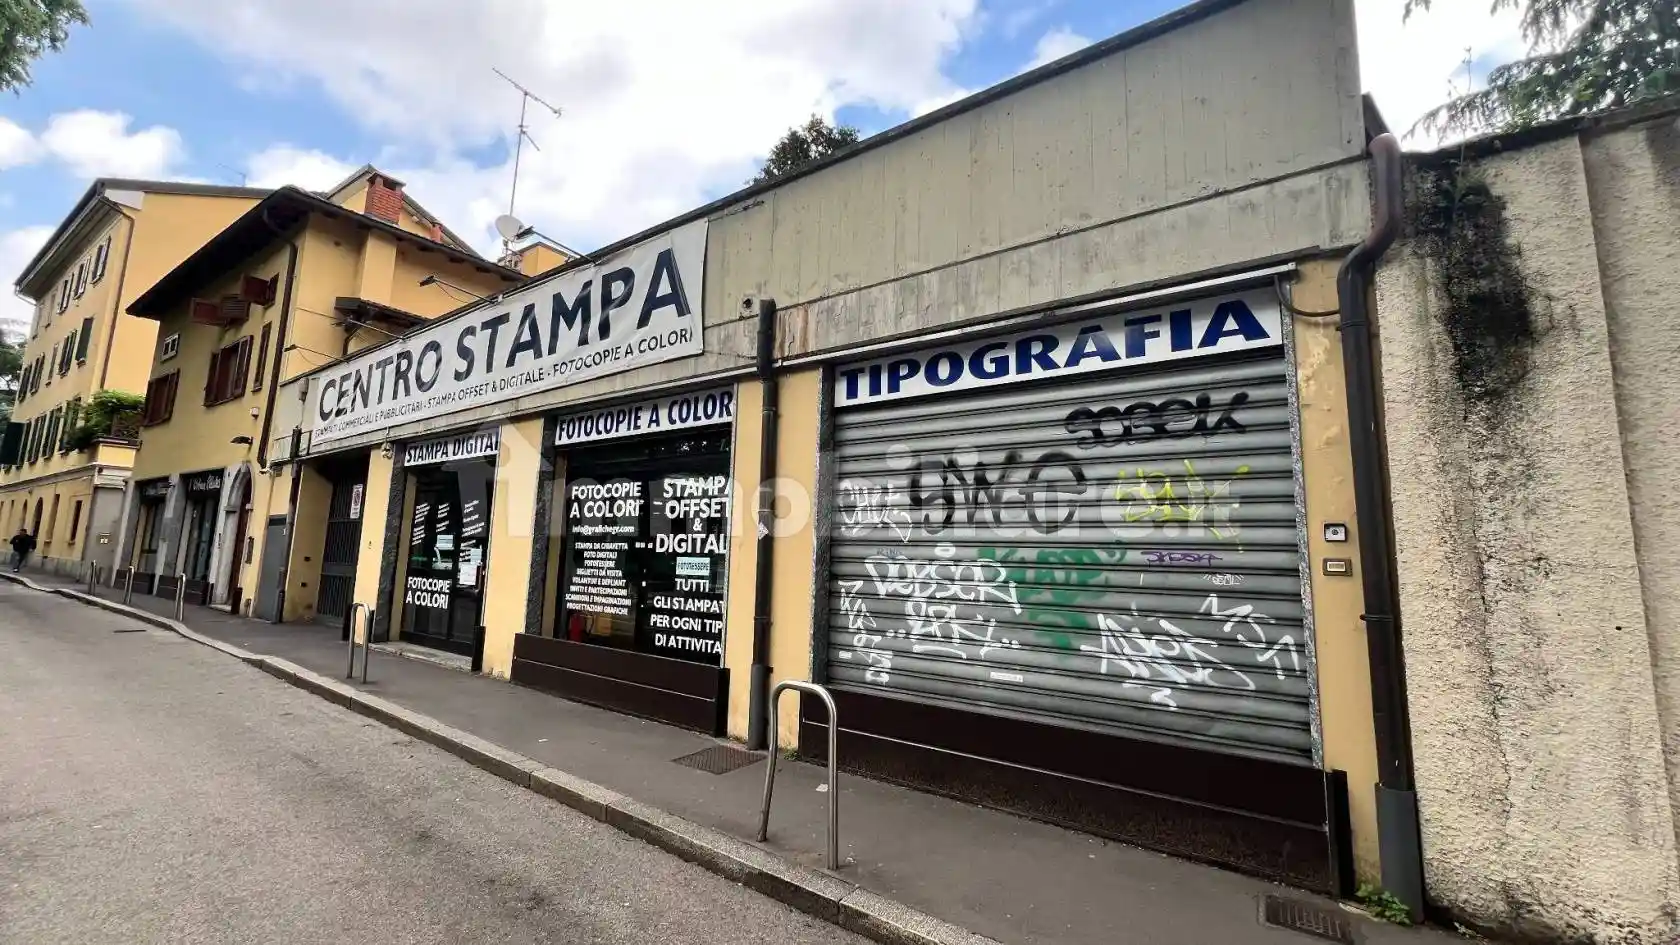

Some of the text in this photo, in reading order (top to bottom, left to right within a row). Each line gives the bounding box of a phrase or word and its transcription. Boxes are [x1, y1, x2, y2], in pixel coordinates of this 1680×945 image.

[319, 247, 691, 421] CENTRO STAMPA
[840, 299, 1270, 400] TIPOGRAFIA
[428, 392, 457, 408] STAMPA
[457, 382, 489, 400] OFFSET
[491, 381, 497, 392] &
[499, 367, 544, 391] DIGITALE
[553, 346, 622, 377] FOTOCOPIE
[624, 344, 633, 358] A
[638, 326, 692, 353] COLORI
[558, 391, 733, 441] FOTOCOPIE A COLOR
[407, 440, 449, 463] STAMPA
[571, 482, 642, 499] FOTOCOPIE
[570, 499, 640, 518] A COLORI
[665, 498, 729, 519] OFFSET
[693, 518, 703, 531] &
[655, 534, 727, 553] DIGITAL
[584, 551, 596, 559] FOTO
[407, 577, 450, 593] FOTOCOPIE
[675, 578, 709, 592] TUTTI
[405, 590, 449, 609] A COLORI
[653, 596, 670, 609] GLI
[650, 614, 723, 634] PER OGNI TIP
[655, 633, 722, 654] DI ATTIVITA
